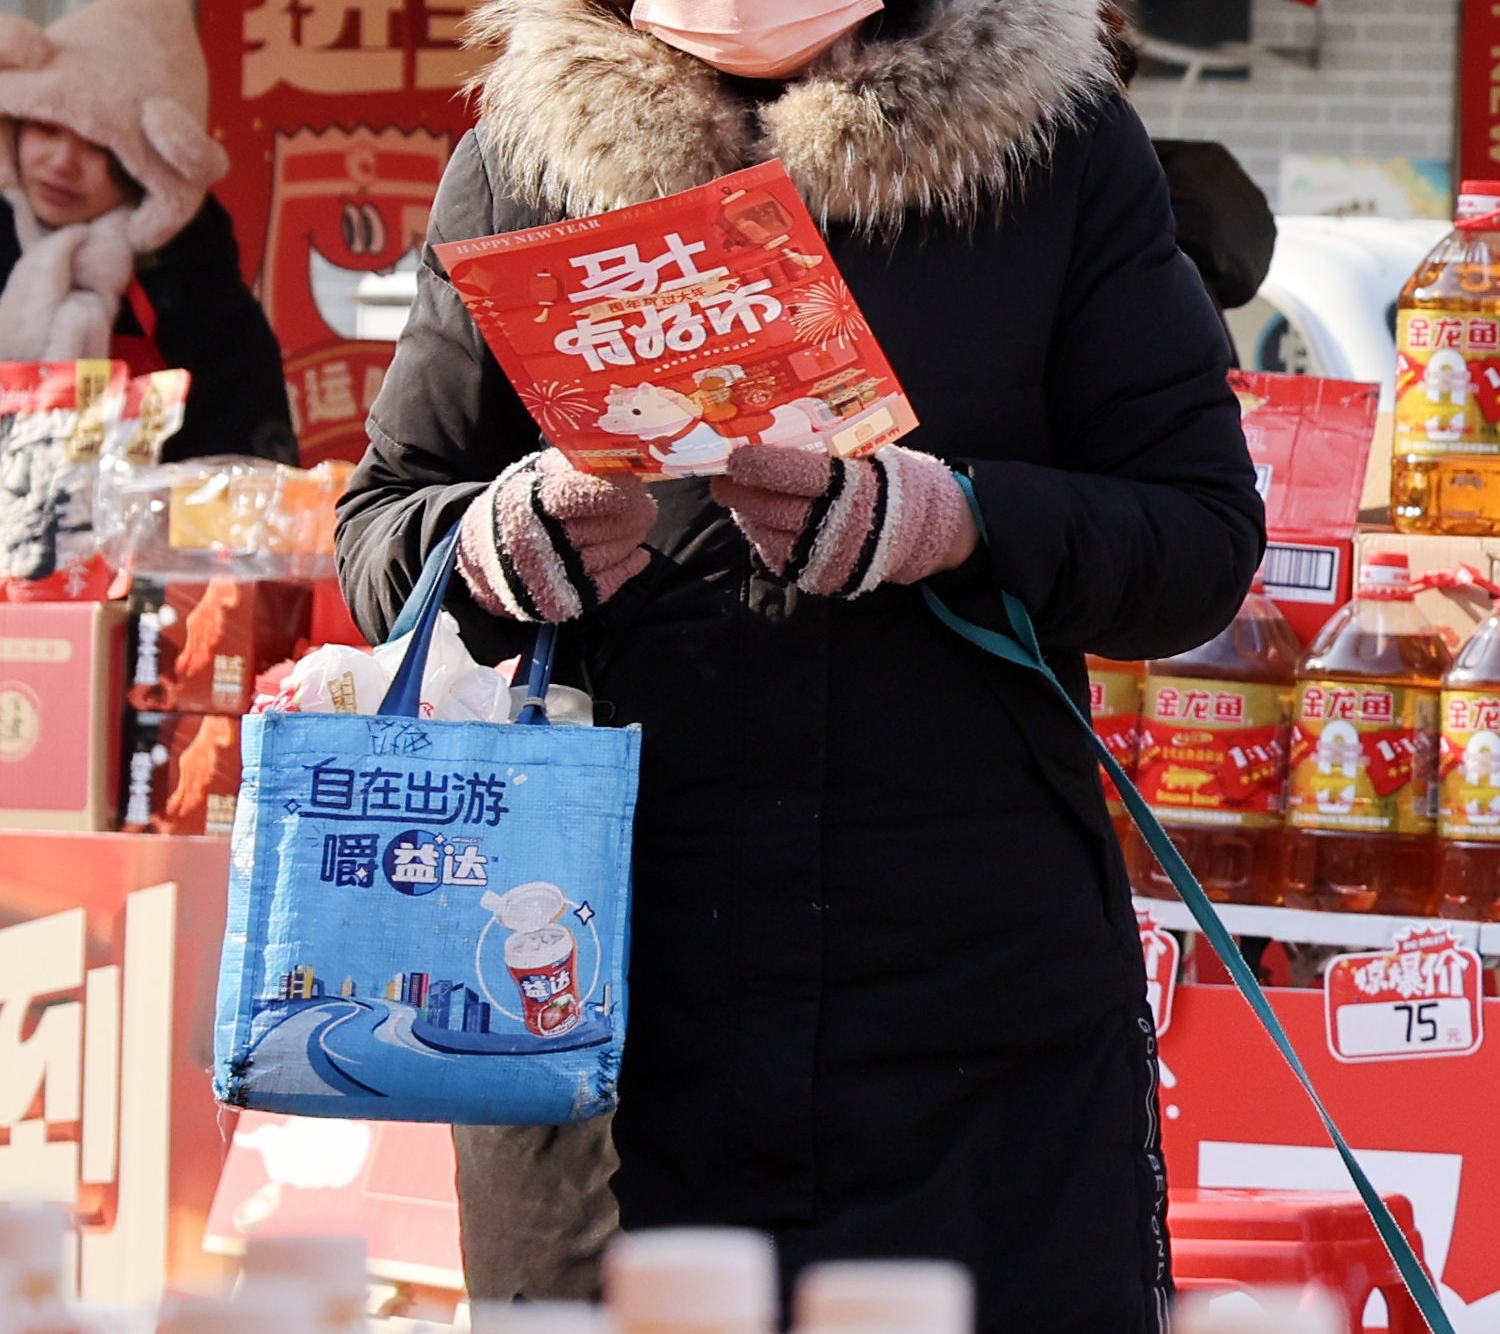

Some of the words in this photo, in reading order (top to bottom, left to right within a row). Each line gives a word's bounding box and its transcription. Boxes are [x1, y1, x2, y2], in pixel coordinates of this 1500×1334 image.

[456, 236, 513, 255] HAPPY
[515, 228, 553, 246] NEW
[553, 218, 602, 238] YEAR
[1406, 316, 1500, 353] 金龙鱼
[1156, 687, 1246, 725] 金龙鱼
[1302, 686, 1395, 723] 金龙鱼
[302, 756, 510, 827] 自在出游
[1354, 948, 1470, 999] 惊爆价
[1392, 1002, 1440, 1045] 75
[1446, 1027, 1463, 1043] 元
